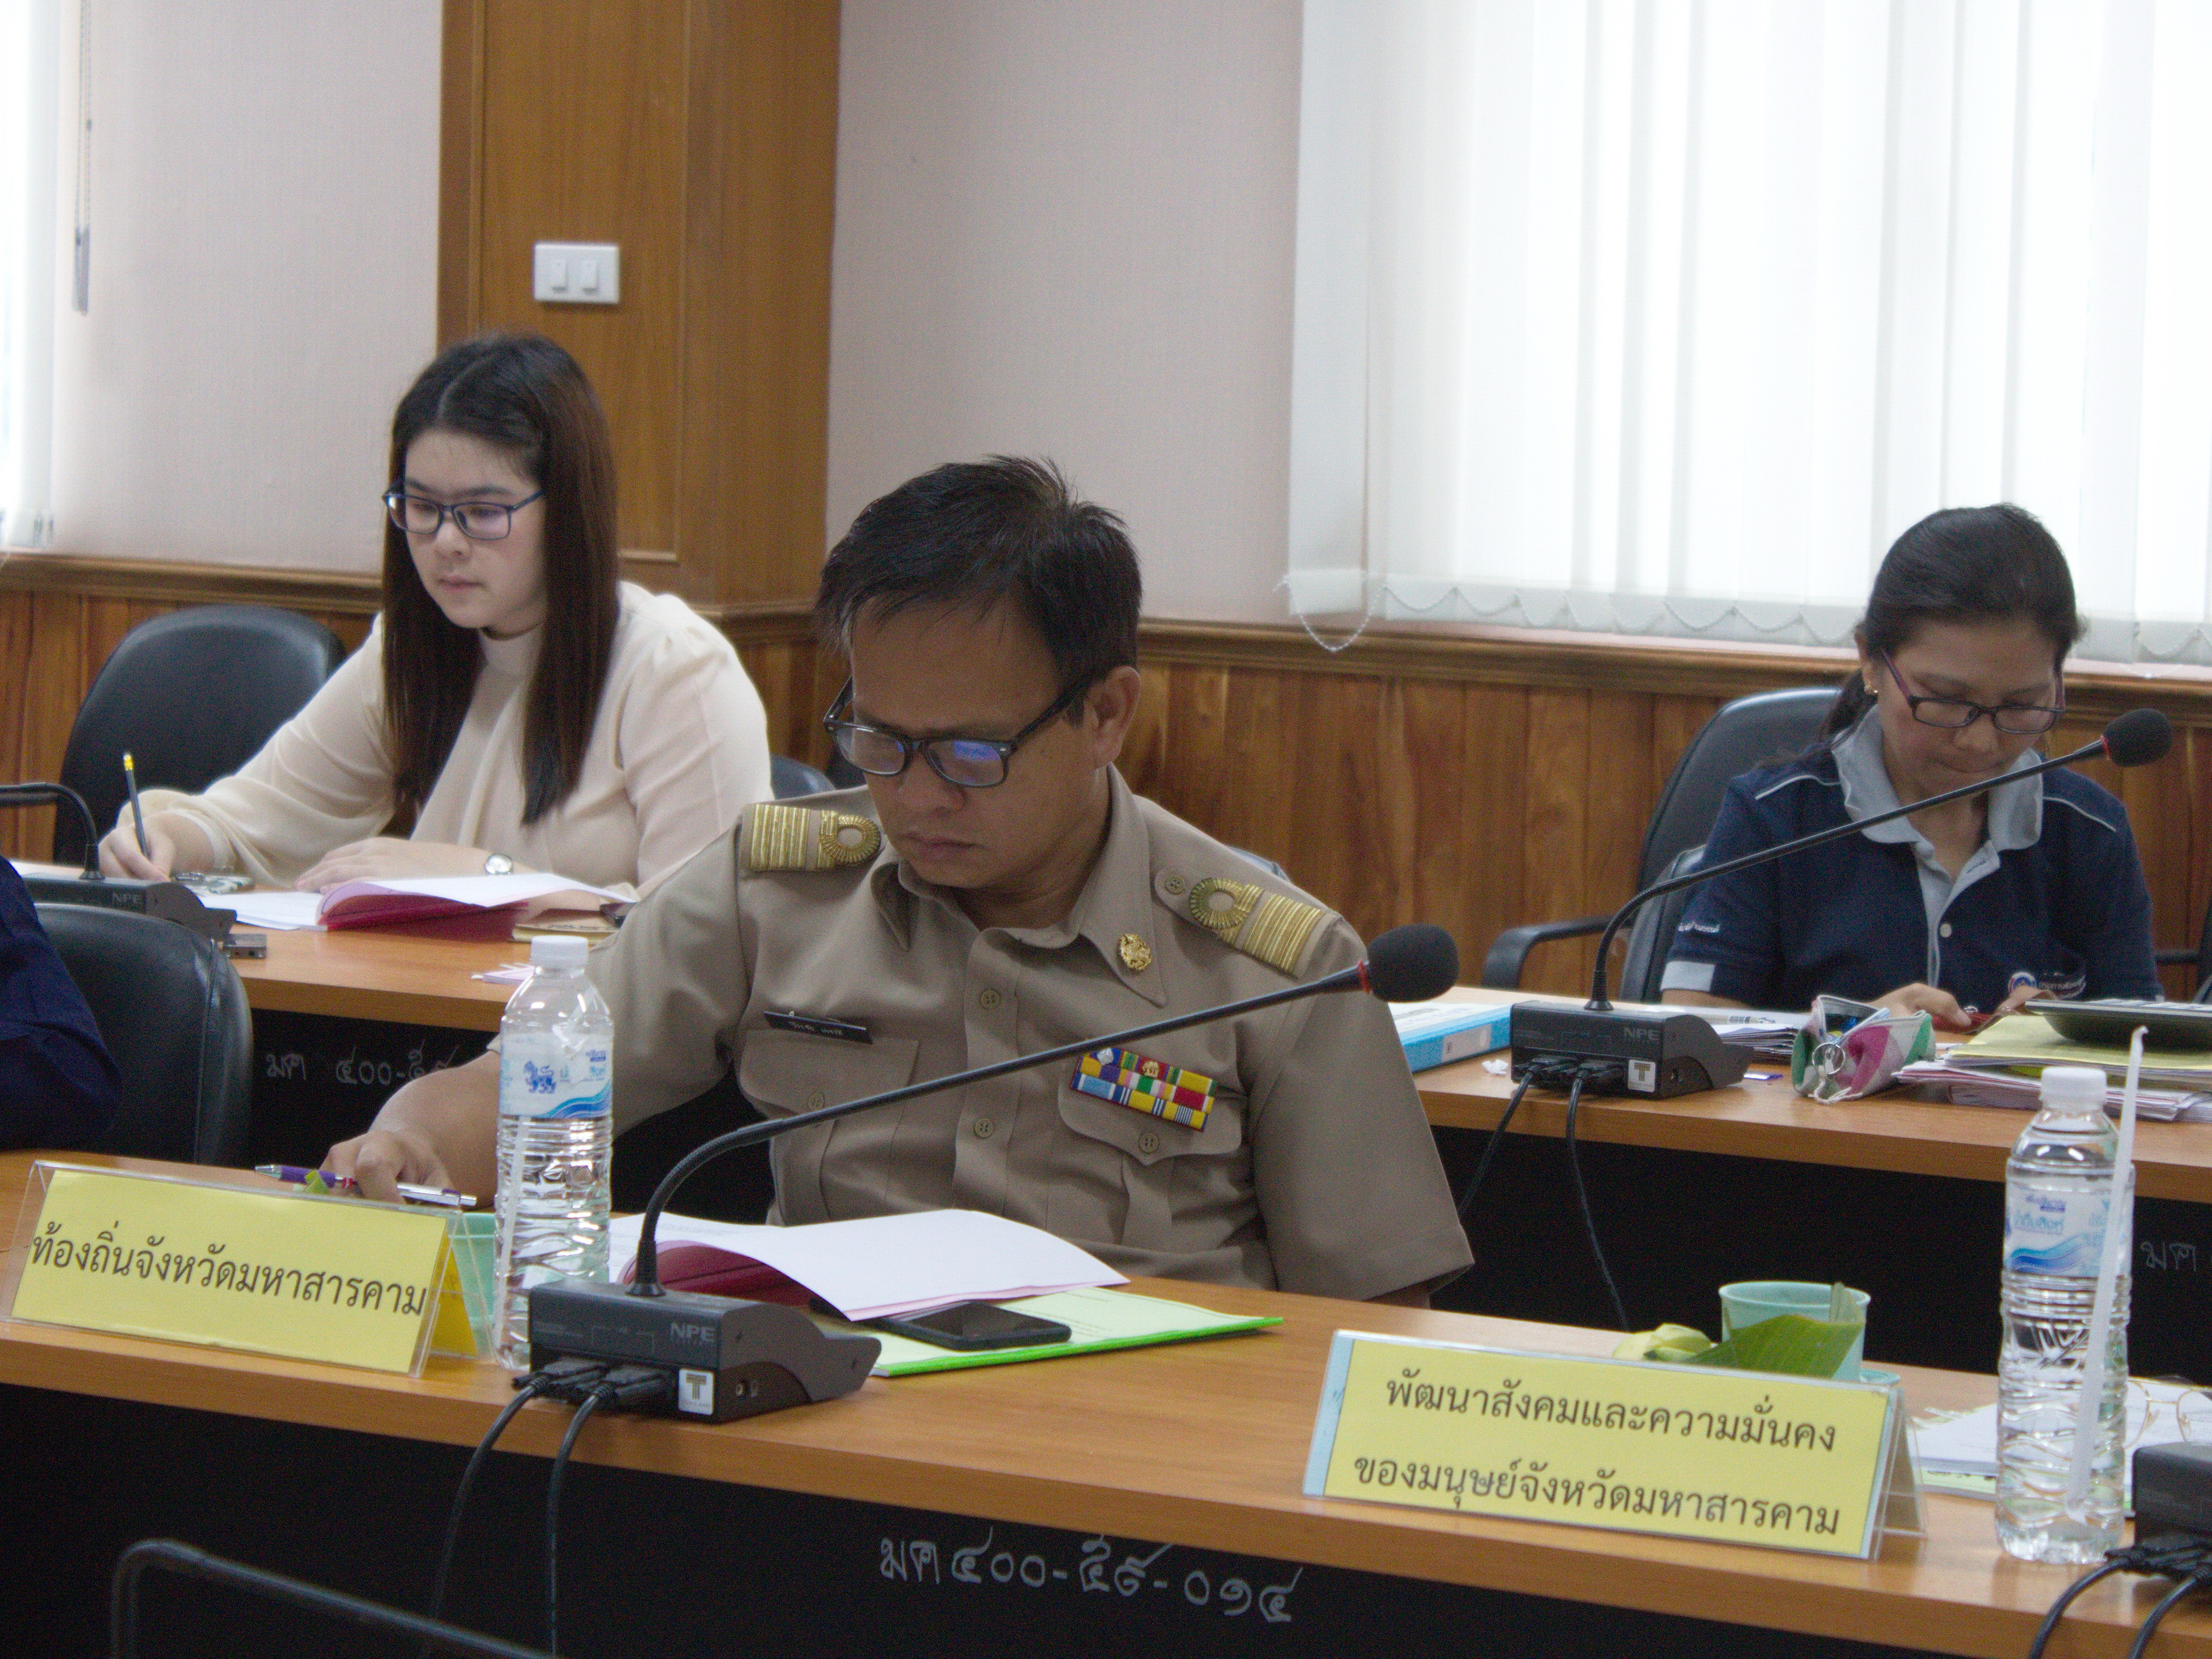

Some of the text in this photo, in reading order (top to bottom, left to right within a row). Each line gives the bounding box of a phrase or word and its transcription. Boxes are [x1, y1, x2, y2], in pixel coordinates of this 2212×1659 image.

[1623, 1026, 1660, 1042] NPE
[32, 1221, 426, 1316] ท้องถิ่นจังหวัดมหาสารคาม
[670, 1322, 716, 1343] NPE
[1386, 1368, 1836, 1453] พัฒนาสังคมและความมั่นคง
[1354, 1457, 1841, 1536] ของมนุษย์จังหวัดมหาสารคาม
